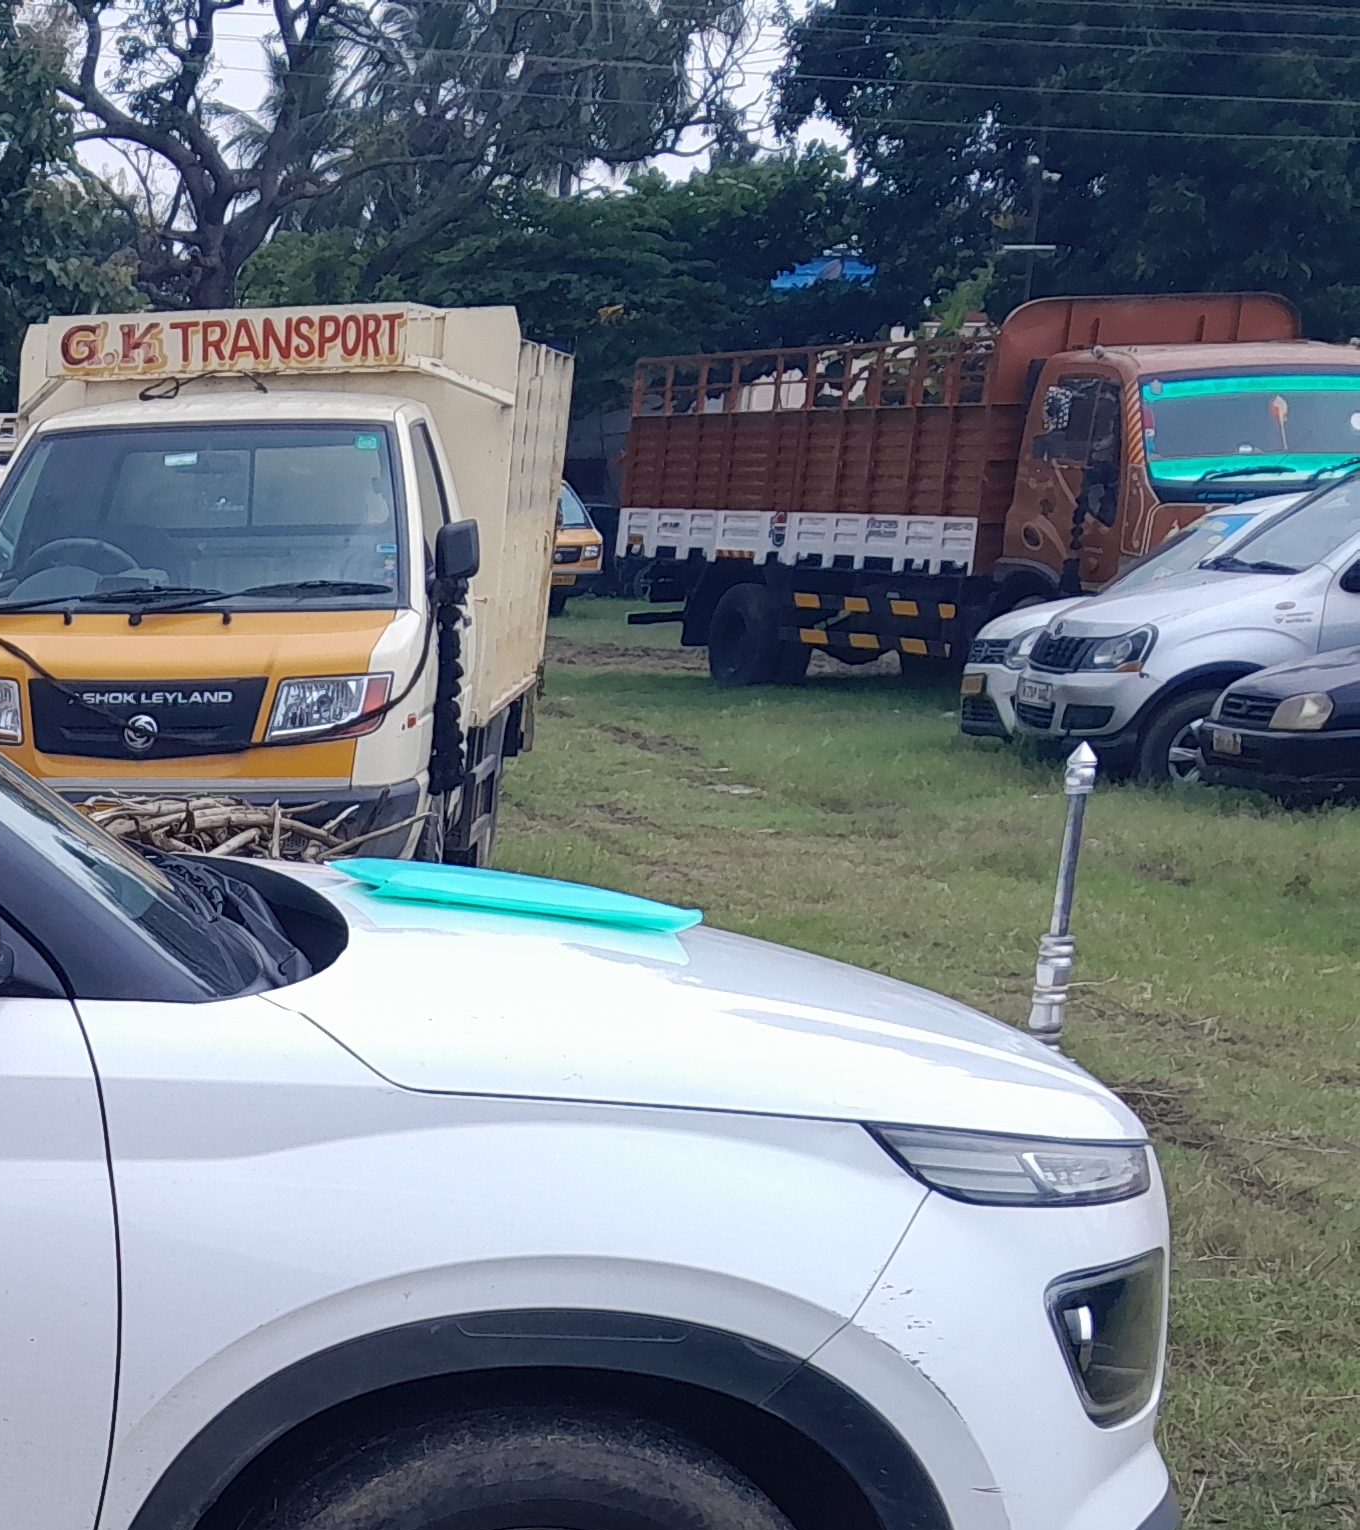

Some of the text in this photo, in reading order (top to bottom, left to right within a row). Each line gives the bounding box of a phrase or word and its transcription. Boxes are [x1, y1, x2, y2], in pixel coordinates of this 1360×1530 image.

[60, 311, 405, 367] G.K TRANSPORT
[140, 691, 233, 704] LEYLAND
